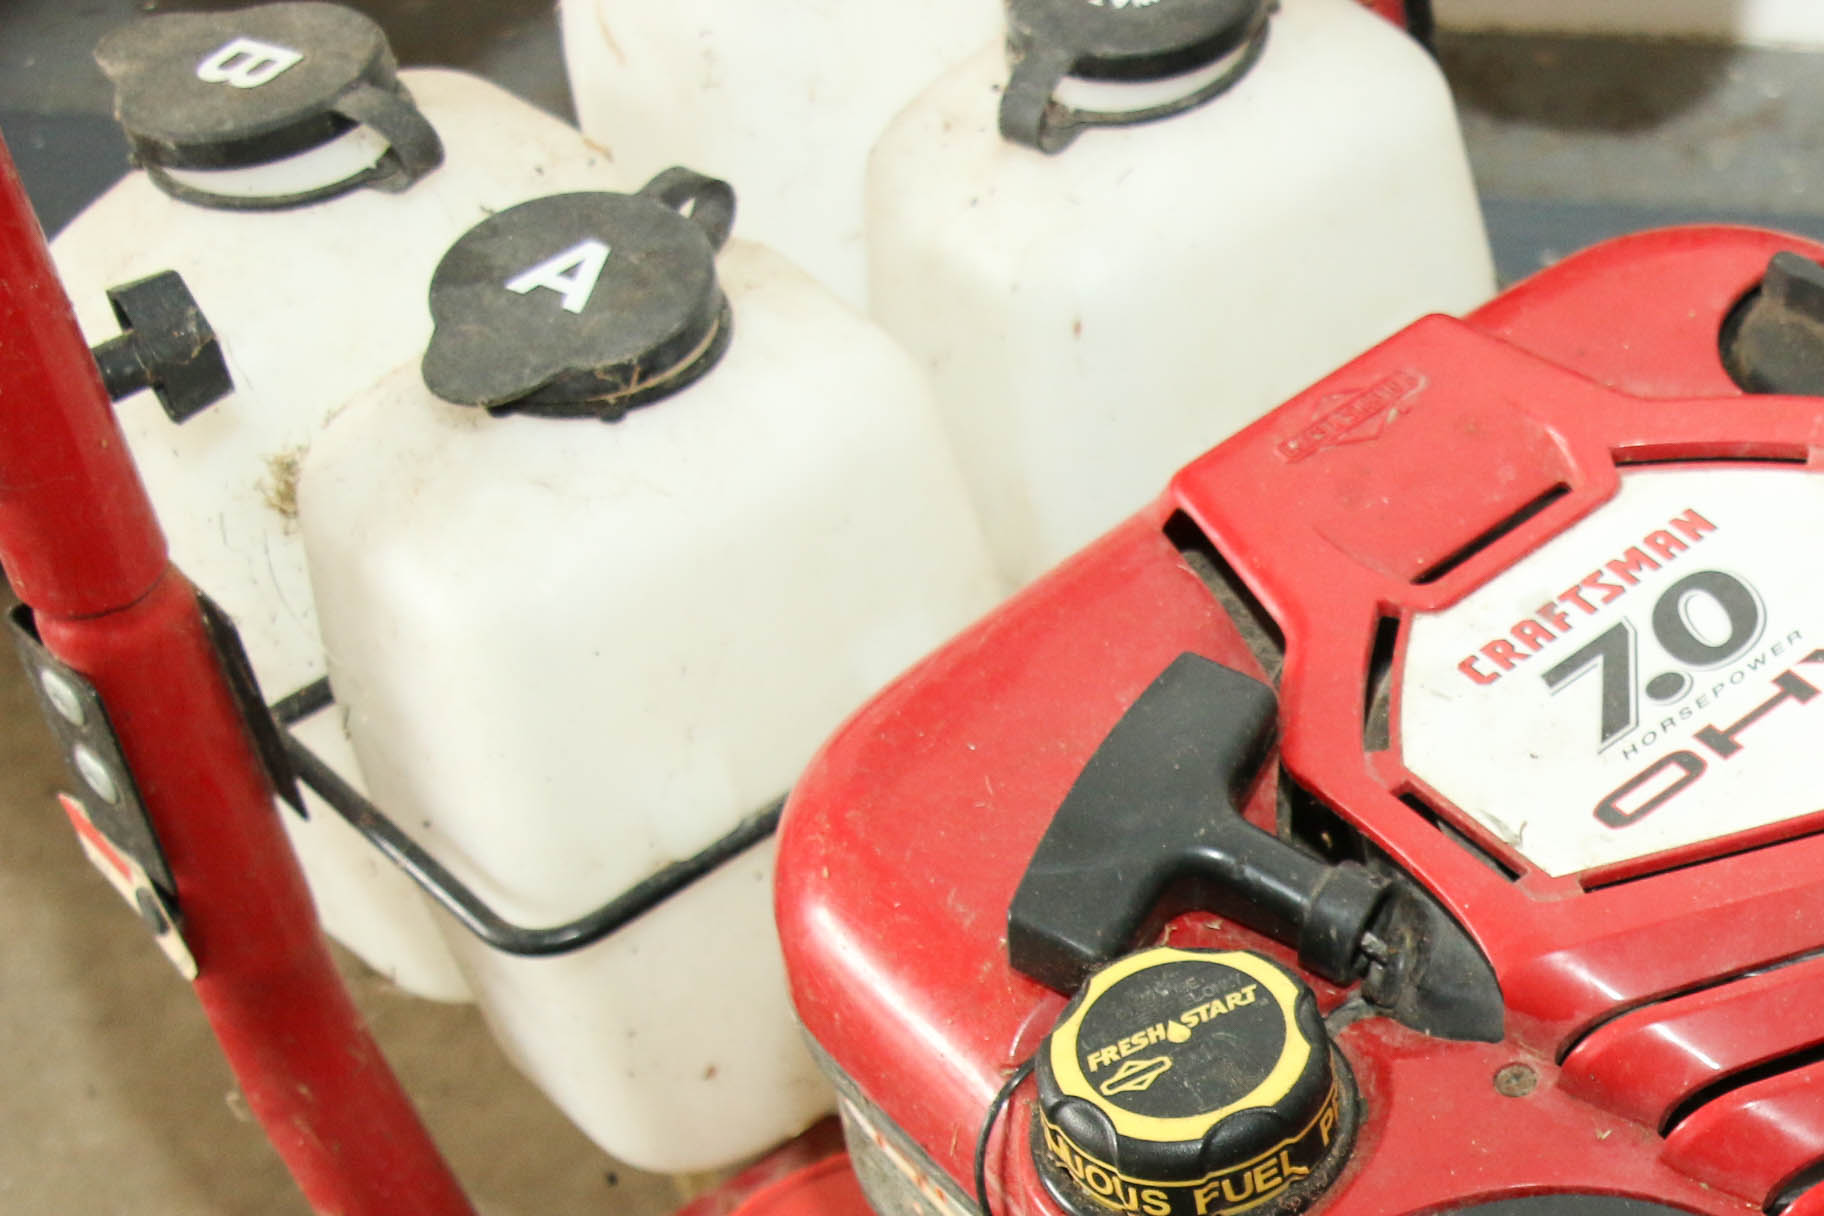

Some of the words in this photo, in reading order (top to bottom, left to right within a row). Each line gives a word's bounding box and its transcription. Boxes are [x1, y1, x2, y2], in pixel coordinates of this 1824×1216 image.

[197, 38, 304, 88] B
[505, 237, 611, 314] A
[1458, 508, 1718, 686] CRAFTSMAN
[1543, 567, 1767, 754] 7.0
[1620, 628, 1805, 760] HORSEPOWER
[1087, 1023, 1167, 1073] FRESH
[1180, 984, 1258, 1027] START
[1193, 1149, 1311, 1216] FUEL
